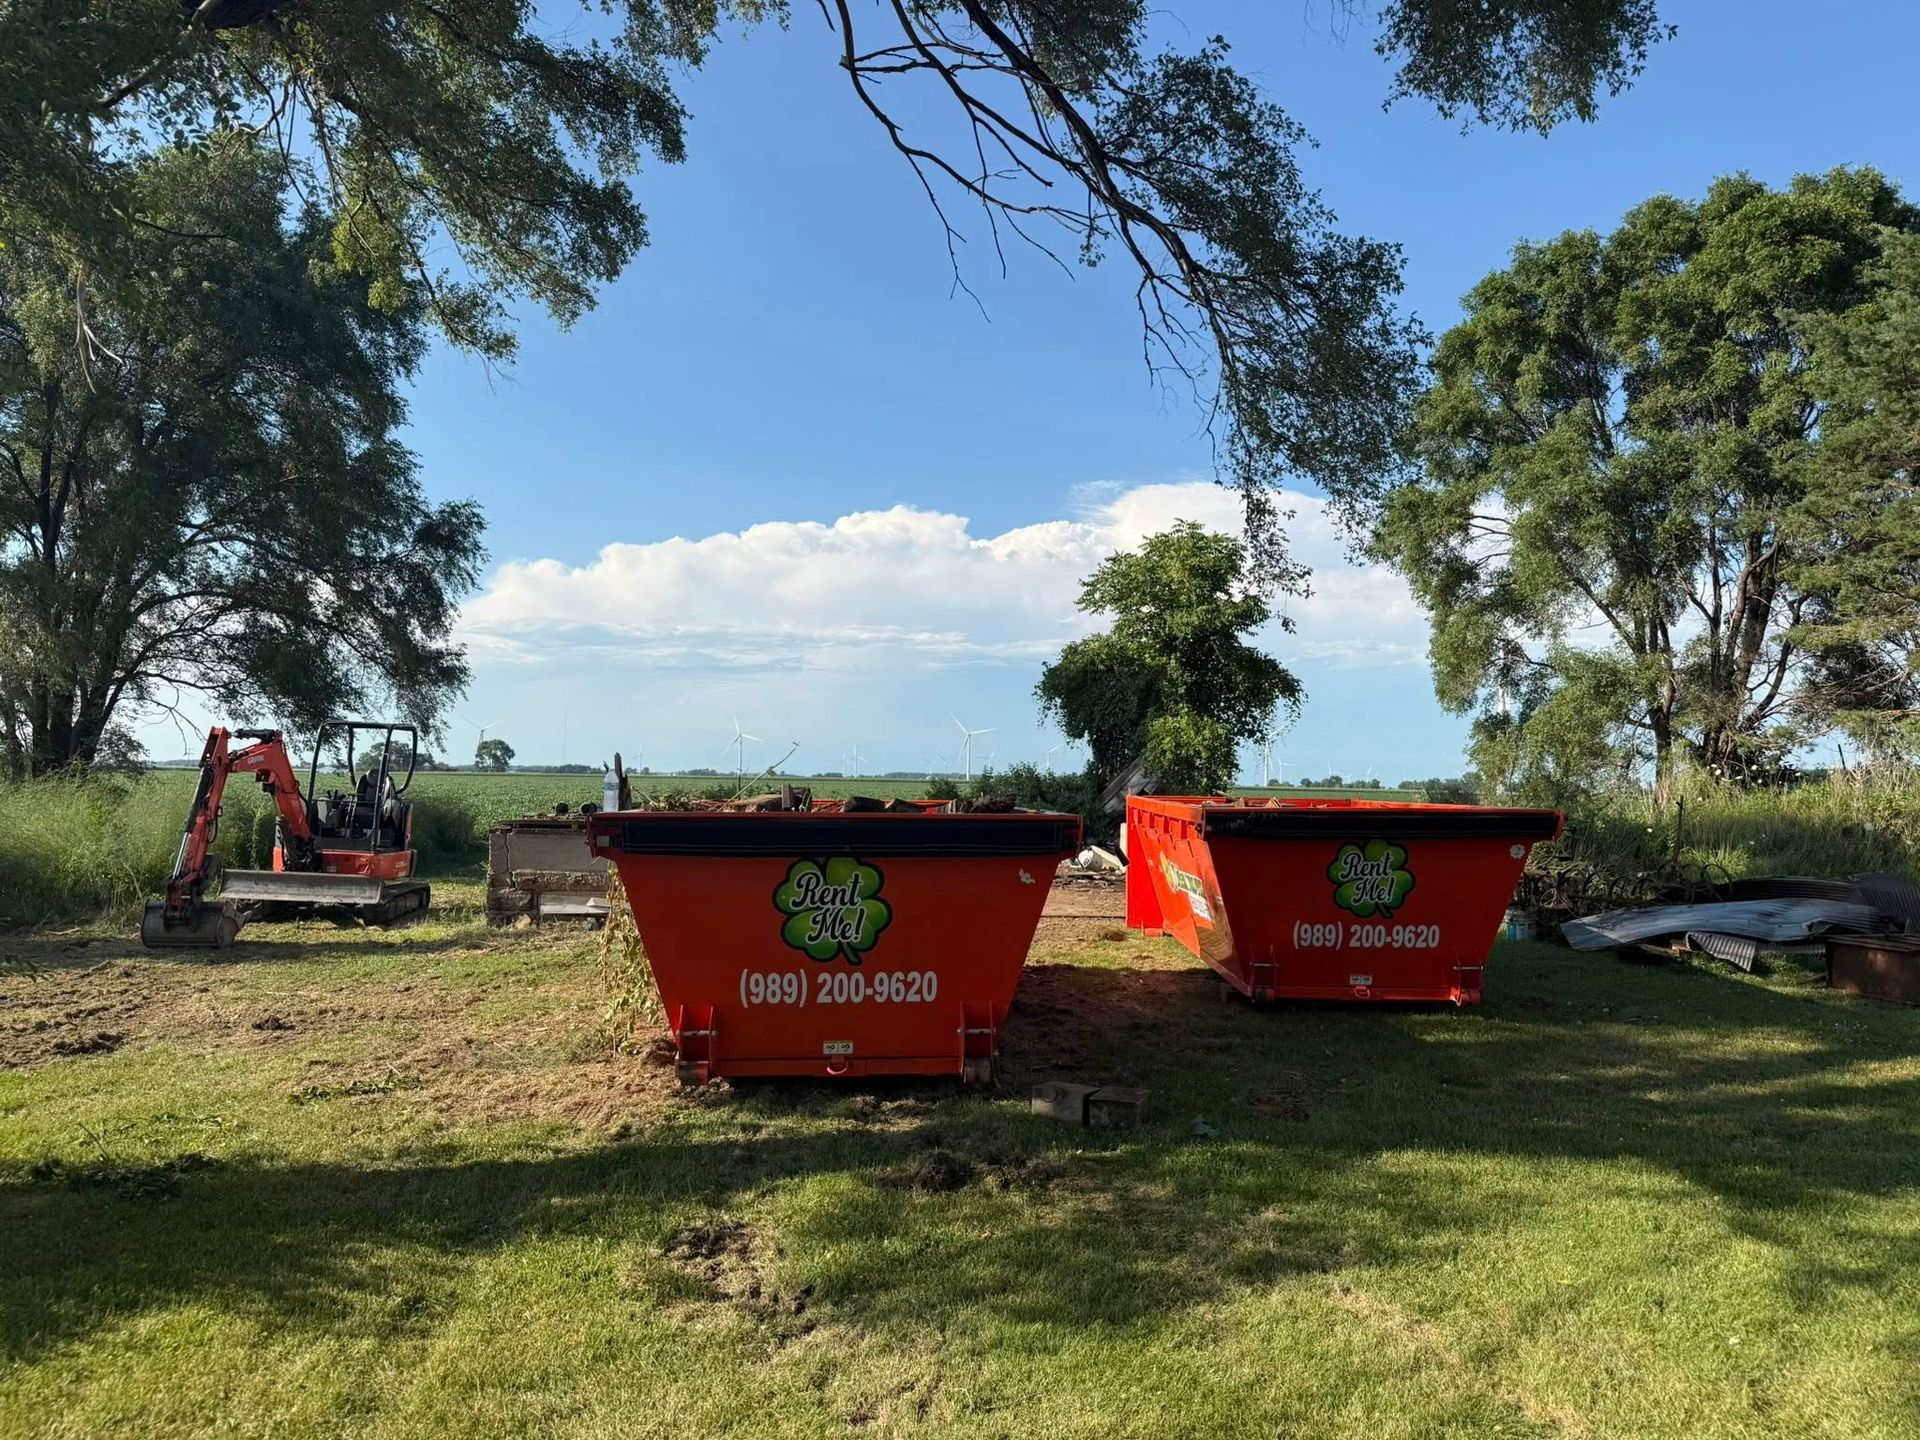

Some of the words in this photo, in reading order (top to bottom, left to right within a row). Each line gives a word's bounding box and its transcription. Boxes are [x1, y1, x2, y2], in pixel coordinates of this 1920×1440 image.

[1340, 851, 1393, 881] Rent
[791, 871, 863, 909] Rent
[1351, 876, 1396, 905] Me!
[806, 907, 866, 943] Me!
[1293, 920, 1343, 950] (989)
[1349, 924, 1440, 948] 200-9620
[740, 968, 808, 1008] (989)
[816, 971, 938, 1003] 200-9620
